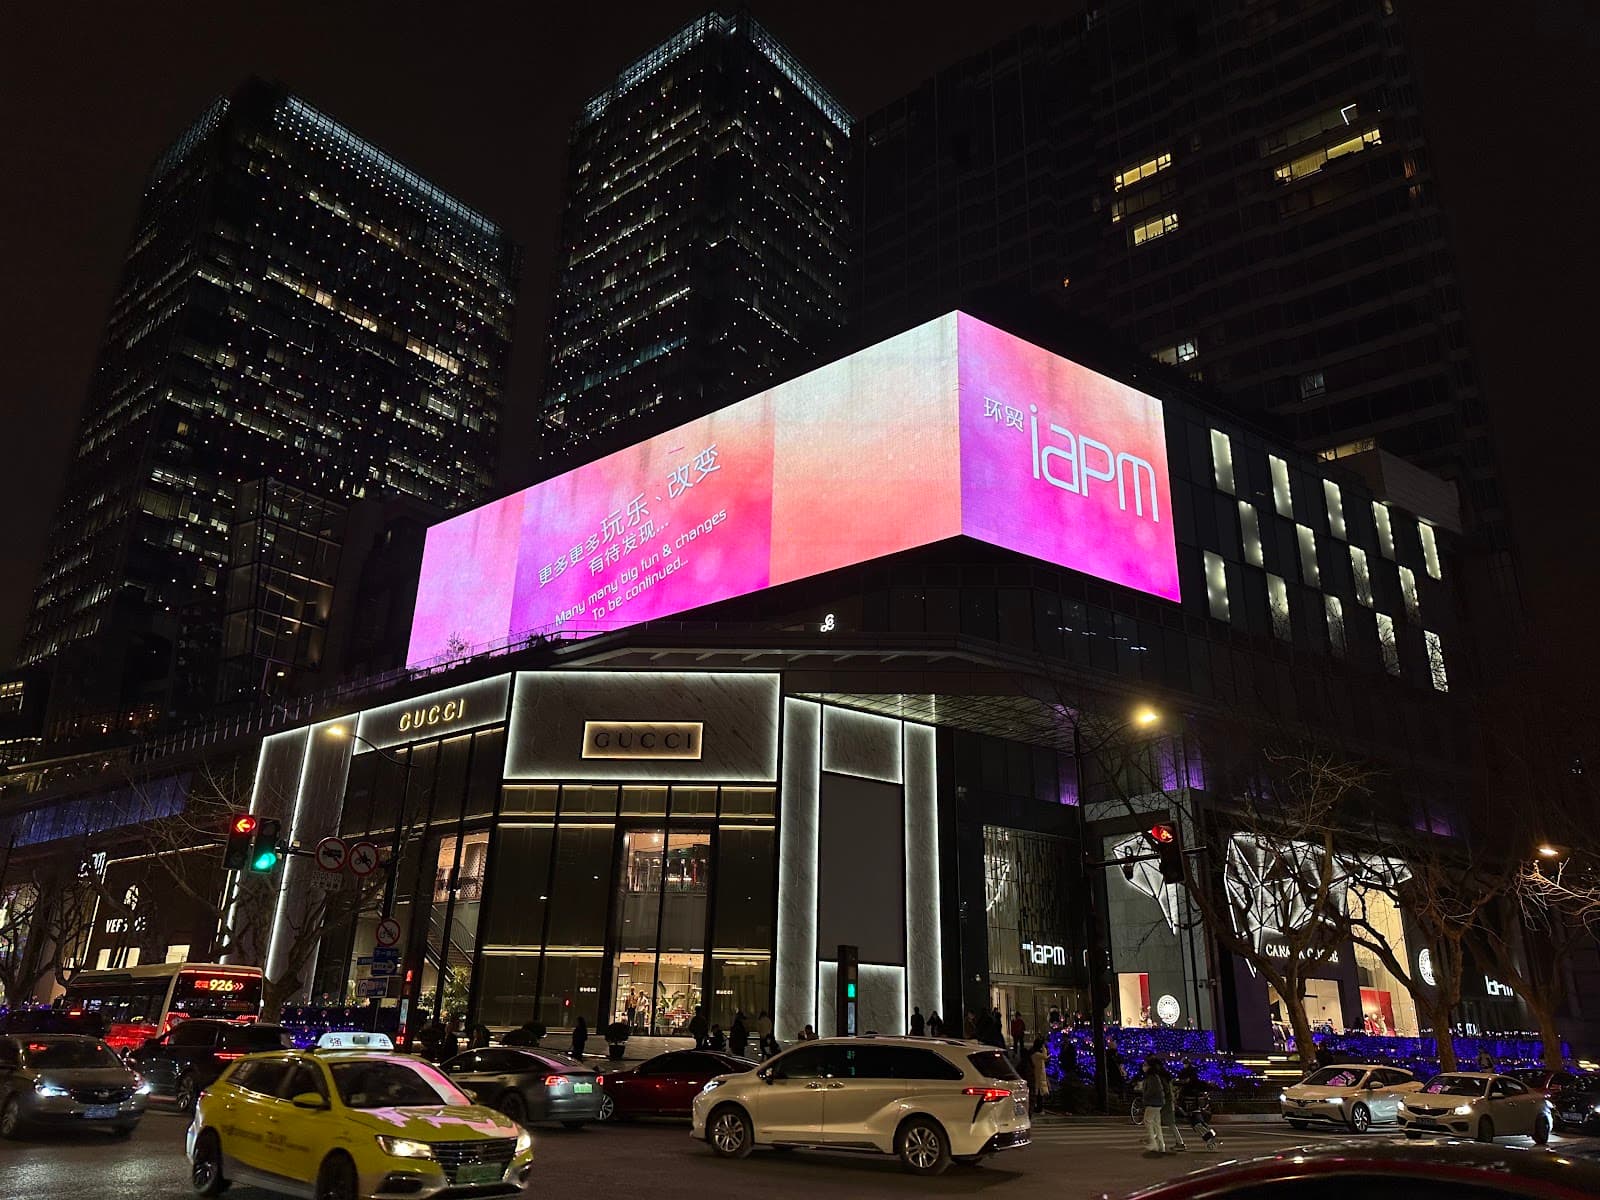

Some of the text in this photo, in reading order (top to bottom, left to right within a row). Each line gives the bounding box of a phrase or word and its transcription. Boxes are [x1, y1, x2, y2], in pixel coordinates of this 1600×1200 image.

[983, 396, 1024, 433] 环贸
[555, 508, 728, 626] Many many big fun & changes
[591, 555, 690, 622] To be continued...
[398, 698, 465, 732] GUCCI
[594, 731, 693, 750] GUCCI
[209, 979, 234, 991] 926
